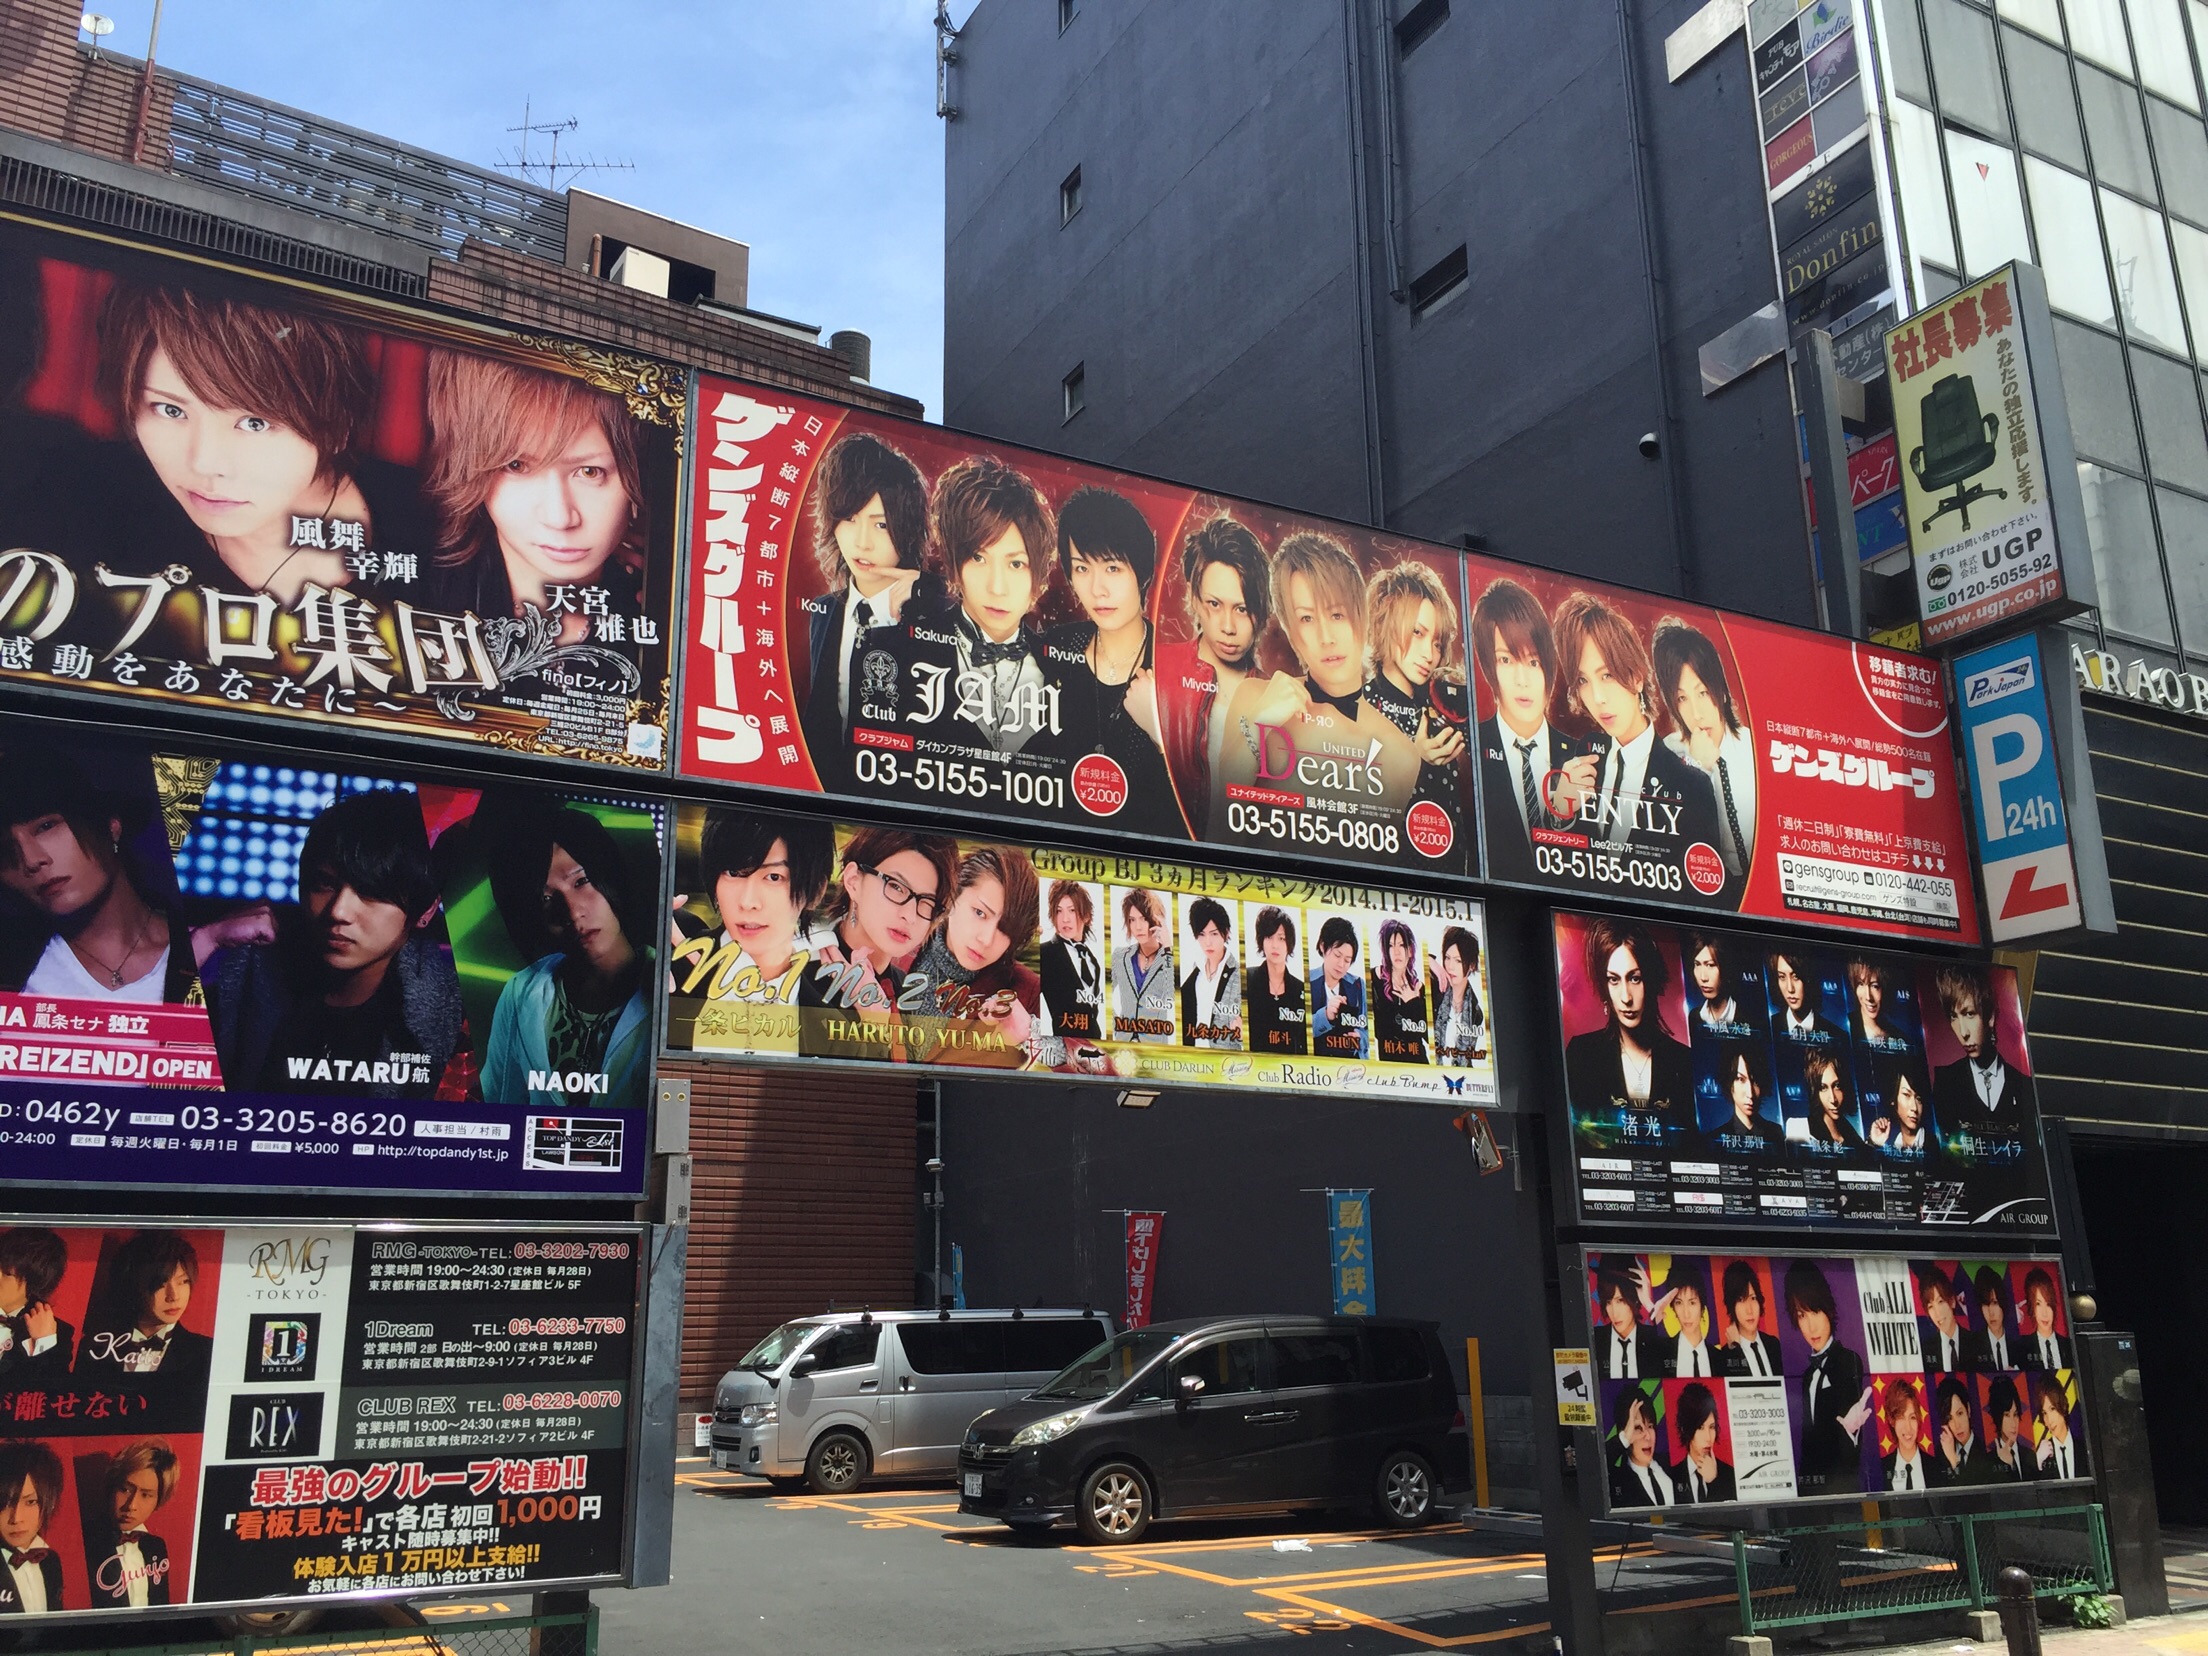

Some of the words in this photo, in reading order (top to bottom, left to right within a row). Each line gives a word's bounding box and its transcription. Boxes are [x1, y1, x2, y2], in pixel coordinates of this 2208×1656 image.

[1770, 133, 1813, 170] GORGEOUS
[1785, 221, 1879, 294] Donfin
[1891, 281, 2013, 383] 社長募集
[1996, 338, 2037, 505] あなたの独立応援します。
[289, 516, 366, 552] 風舞
[1928, 512, 2038, 563] まずはお問い合わせ下さい。
[1982, 527, 2043, 569] UGP
[345, 551, 419, 583] 幸輝
[697, 392, 796, 764] ゲンズグループ
[1947, 553, 2052, 607] 0120-5055-92
[545, 584, 611, 614] 天宮
[801, 598, 827, 614] Kou
[1927, 578, 2057, 636] www.ugp.co.jp
[595, 613, 661, 645] 雅也
[915, 627, 957, 646] Sakura
[1048, 646, 1086, 664] Ryuya
[1868, 655, 1937, 686] 移籍者求む!
[1182, 676, 1220, 694] Miyabi
[862, 703, 897, 722] Club
[906, 662, 1063, 737] JAM
[1382, 701, 1416, 717] Sakura
[859, 732, 909, 749] クラブジャム
[1322, 741, 1366, 759] UNITED
[855, 750, 1064, 808] 03-5155-1001
[1080, 767, 1120, 783] 新規料金
[1769, 739, 1936, 798] ゲンズグループ
[1971, 713, 2043, 842] P
[1080, 788, 1121, 805] ¥2,000
[1230, 787, 1301, 806] ユナイテッドディアーズ
[1306, 796, 1359, 815] 風林会館3F
[1542, 769, 1683, 836] GENTLY
[1412, 812, 1447, 827] 新規料金
[2005, 795, 2057, 836] 24h
[1228, 803, 1399, 853] 03-5155-0808
[1413, 832, 1449, 848] ¥2,000
[1780, 835, 1910, 867] 求人のお問い合わせはコチラ
[1030, 847, 1107, 882] Group
[1113, 858, 1141, 883] BJ
[1535, 846, 1683, 892] 03-5155-0303
[1691, 871, 1721, 886] ¥2,000
[1795, 861, 1860, 885] gensgroup
[1875, 872, 1952, 898] 0120-442-055
[671, 936, 811, 1003] No.1
[815, 960, 930, 1011] No.2
[36, 1003, 57, 1013] 部長
[935, 981, 1017, 1019] No.3
[1076, 990, 1105, 1004] No.4
[1146, 996, 1173, 1010] No.5
[1213, 1002, 1239, 1016] No.6
[1279, 1007, 1305, 1022] No.7
[1341, 1012, 1367, 1027] No.8
[109, 1015, 149, 1034] 独立
[827, 1018, 926, 1047] HARUTO
[1059, 1013, 1089, 1030] 大翔
[1115, 1017, 1175, 1036] MASATO
[1402, 1018, 1427, 1033] No.9
[1456, 1023, 1484, 1037] No.10
[935, 1028, 1008, 1053] YU-MA
[1326, 1035, 1361, 1050] SHUN
[152, 1058, 212, 1079] OPEN
[389, 1052, 431, 1064] 幹部補佐
[1142, 1059, 1171, 1071] CLUB
[1173, 1060, 1214, 1074] DARLIN
[287, 1057, 410, 1084] WATARU
[412, 1067, 430, 1083] 航
[528, 1070, 609, 1093] NAOKI
[1257, 1071, 1279, 1083] Club
[1282, 1064, 1332, 1087] Radio
[1367, 1076, 1397, 1088] club
[1400, 1074, 1441, 1090] Bump
[25, 1099, 120, 1130] 0462y
[181, 1105, 406, 1136] 03-3205-8620
[75, 1136, 101, 1145] 定休日
[295, 1143, 339, 1155] ¥5,000
[377, 1144, 509, 1161] http://topdandy1st.jp
[2000, 1214, 2015, 1224] AIR
[2018, 1214, 2048, 1225] GROUP
[249, 1236, 331, 1286] RMG
[372, 1242, 417, 1259] RMG
[479, 1248, 513, 1260] TEL:
[513, 1242, 630, 1260] 03-3202-7930
[370, 1264, 423, 1276] 営業時間
[368, 1279, 564, 1291] 東京都新宿区歌舞伎町1-2-7星座館ビル
[567, 1280, 581, 1290] 5F
[1863, 1291, 1886, 1314] Club
[1884, 1281, 1913, 1315] ALL
[364, 1320, 434, 1338] 1Dream
[472, 1323, 506, 1336] TEL:
[508, 1317, 626, 1335] 03-6233-7750
[363, 1342, 416, 1355] 営業時間
[420, 1344, 437, 1354] 2部
[1866, 1322, 1919, 1356] WHITE
[580, 1355, 594, 1365] 4F
[357, 1398, 413, 1416] CLUB
[416, 1397, 456, 1415] REX
[467, 1400, 500, 1413] TEL:
[502, 1390, 622, 1410] 03-6228-0070
[250, 1406, 299, 1447] REX
[355, 1420, 409, 1435] 営業時間
[581, 1430, 595, 1441] 4F
[250, 1455, 589, 1507] 最強のグループ始動!!
[341, 1528, 501, 1552] キャスト随時募集中!!
[307, 1566, 526, 1594] お気軽に各店にお問い合わせ下さい!
